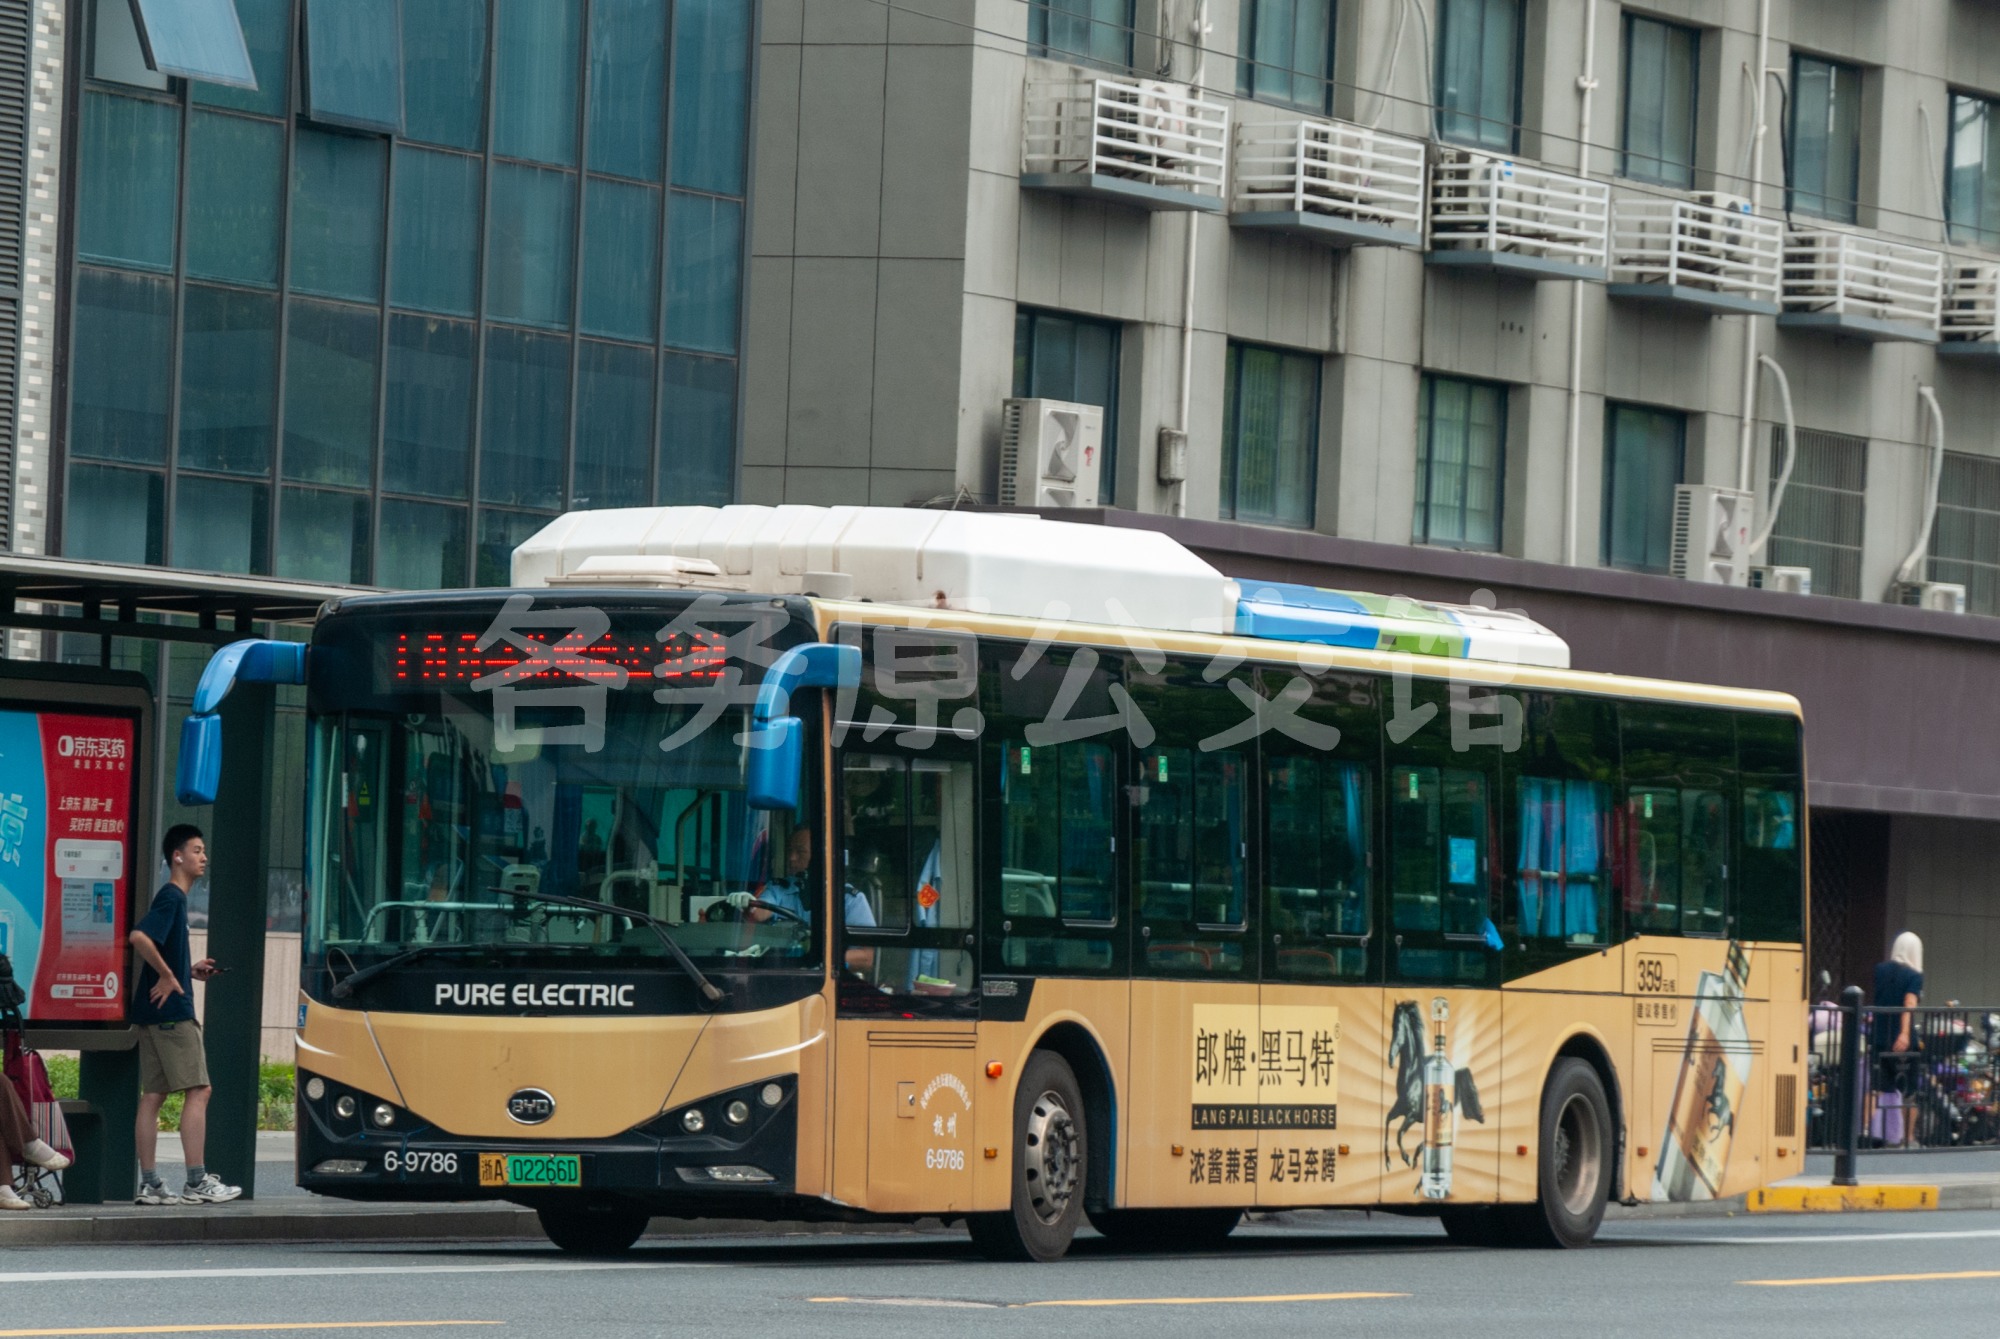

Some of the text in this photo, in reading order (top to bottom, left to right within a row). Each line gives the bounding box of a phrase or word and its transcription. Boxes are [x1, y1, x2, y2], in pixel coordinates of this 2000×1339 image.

[74, 736, 125, 759] 京东买药
[58, 796, 81, 811] 上京东
[69, 817, 93, 832] 买好药
[435, 983, 635, 1006] PURE ELECTRIC
[511, 1099, 550, 1114] BYD
[1193, 1108, 1335, 1126] LANG PAI BLACK HORSE
[384, 1150, 458, 1174] 6-9786
[513, 1158, 578, 1182] 02266D
[926, 1148, 965, 1170] 6-9786
[1189, 1147, 1336, 1184] 浓酱兼香 龙马奔腾
